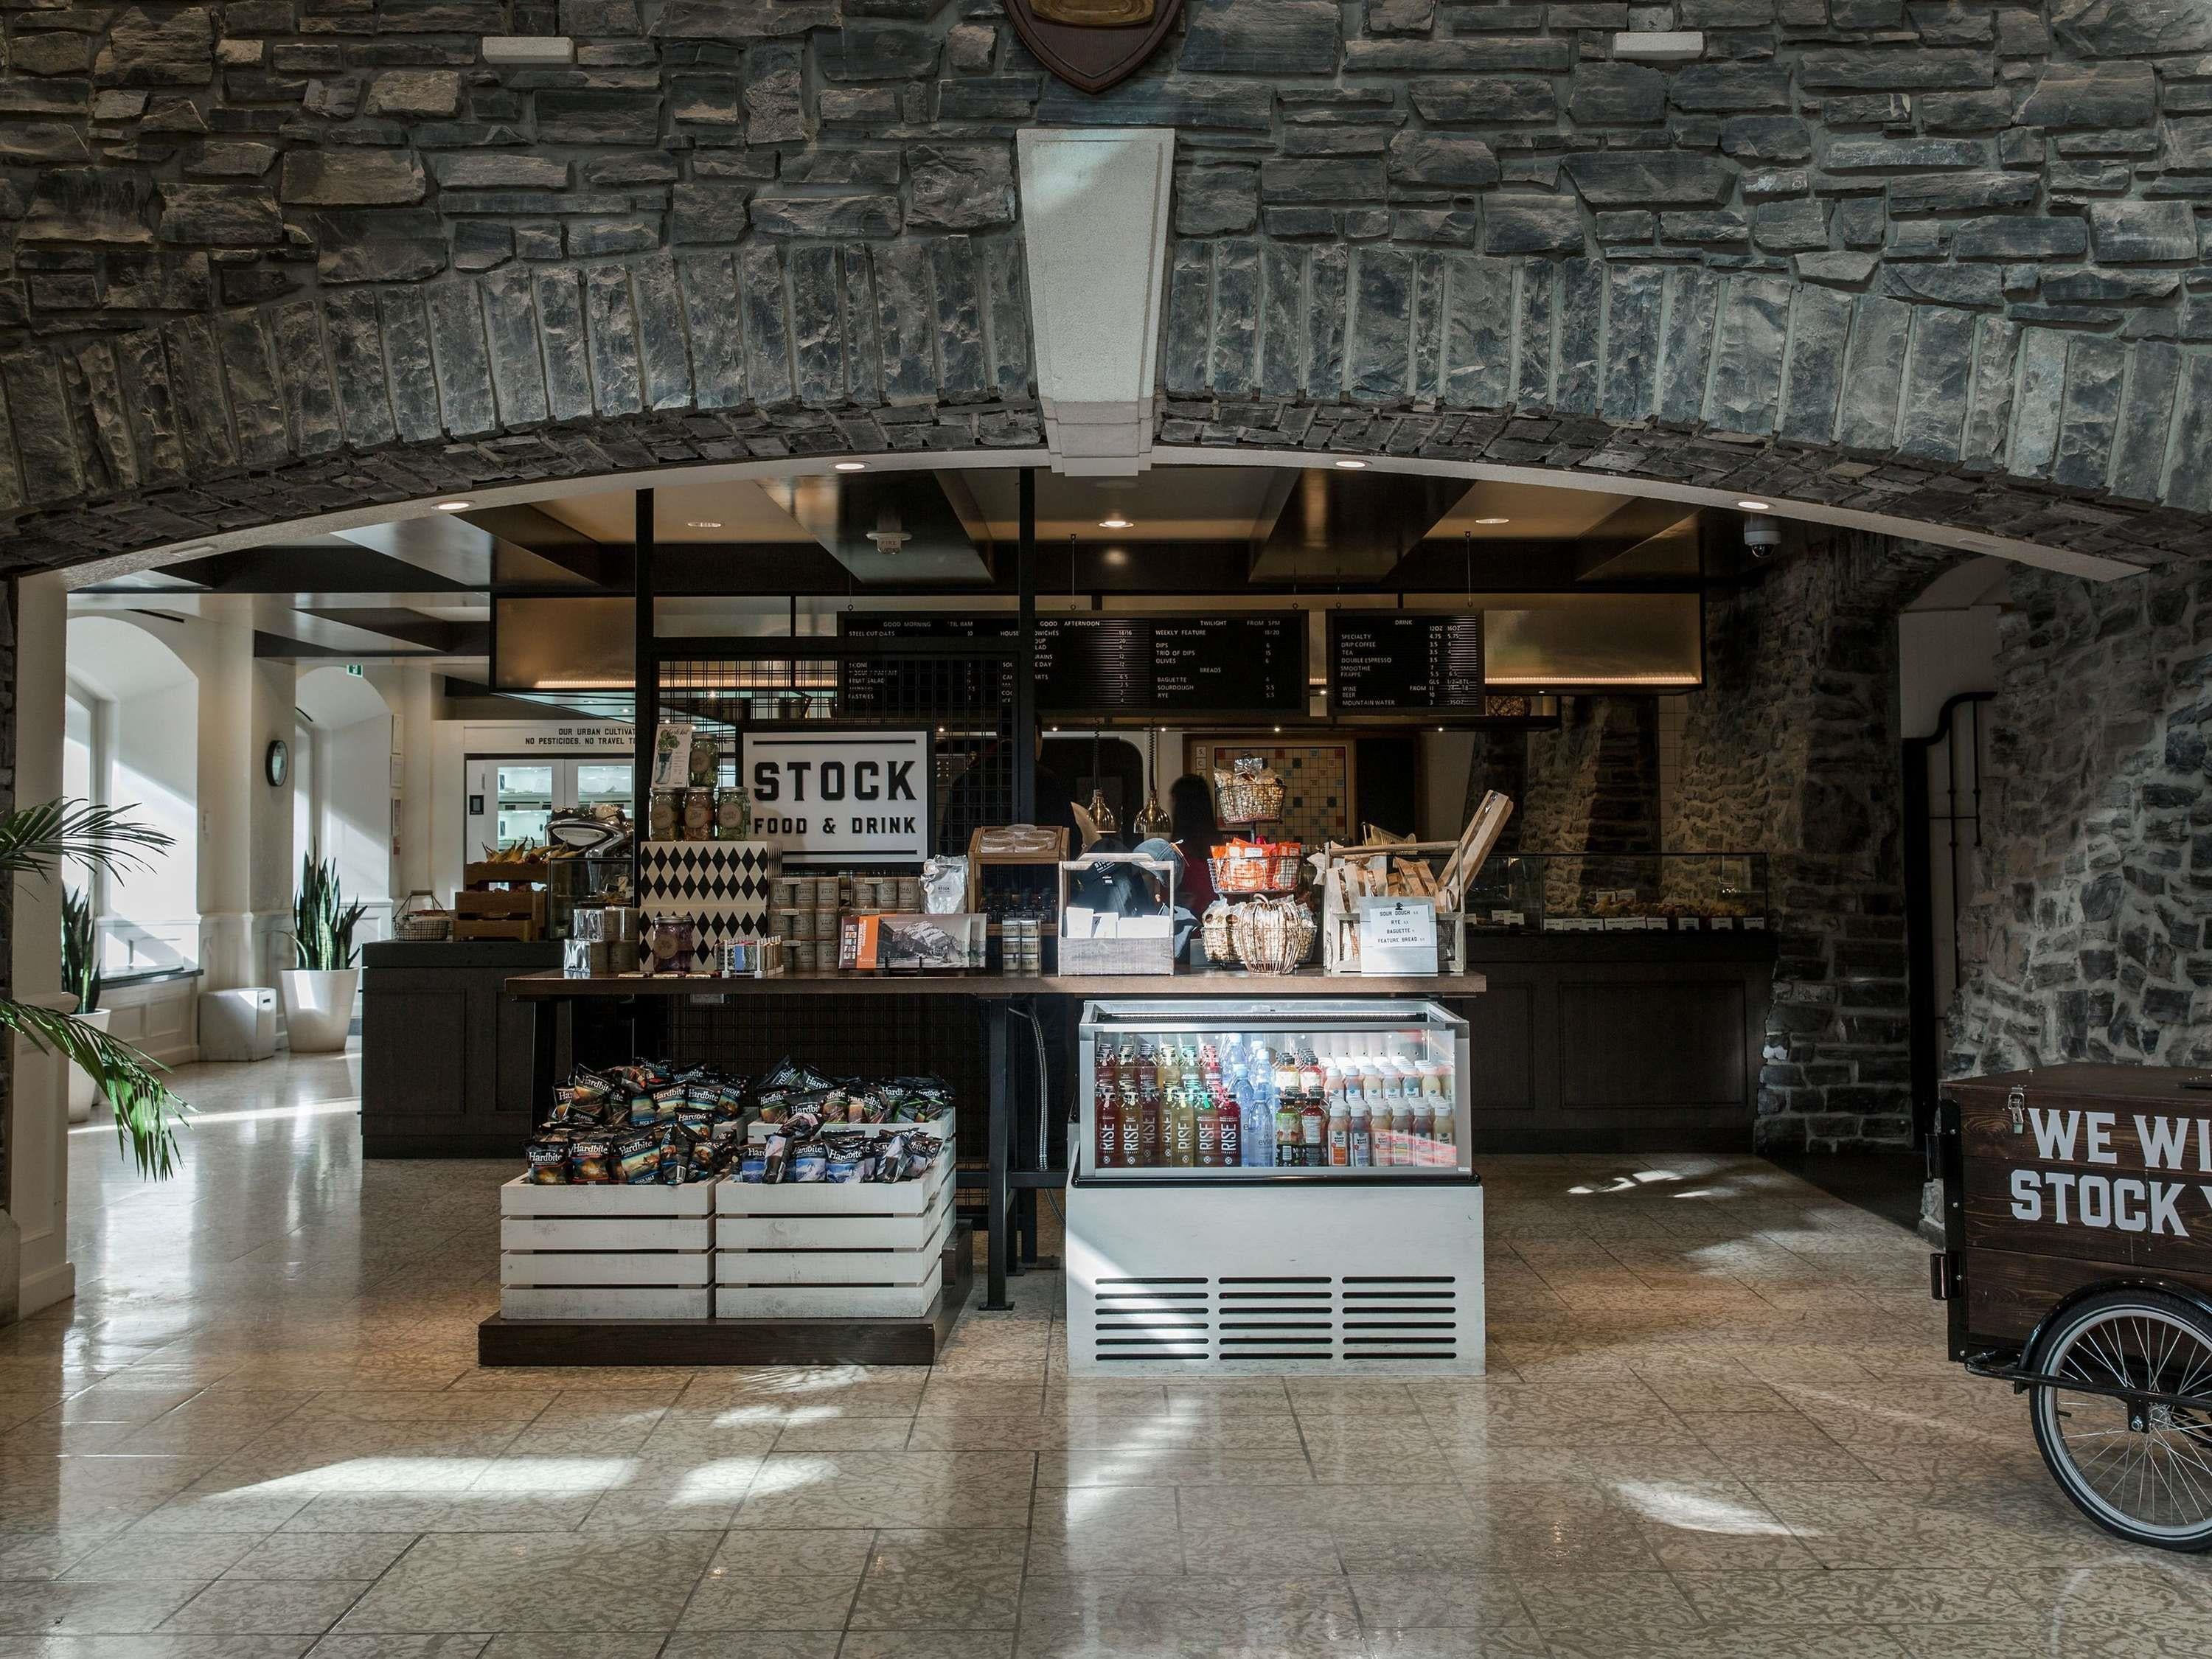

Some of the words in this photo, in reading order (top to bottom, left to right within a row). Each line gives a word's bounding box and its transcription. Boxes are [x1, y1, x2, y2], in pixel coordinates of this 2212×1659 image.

[754, 761, 917, 801] STOCK
[754, 818, 807, 834] FOOD
[822, 818, 837, 834] &
[852, 817, 917, 834] DRINK
[689, 1088, 719, 1102] Hardbite
[574, 1144, 608, 1155] Hardbite
[619, 1141, 653, 1155] Hardbite
[1099, 1123, 1115, 1151] RISE
[1124, 1123, 1139, 1151] RISE
[1178, 1122, 1193, 1150] RISE
[1199, 1123, 1215, 1151] RISE
[1221, 1123, 1237, 1151] RISE
[2028, 1107, 2118, 1164] WE
[2133, 1114, 2212, 1172] WI
[529, 1151, 563, 1163] Hardbite
[2011, 1169, 2190, 1237] STOCK
